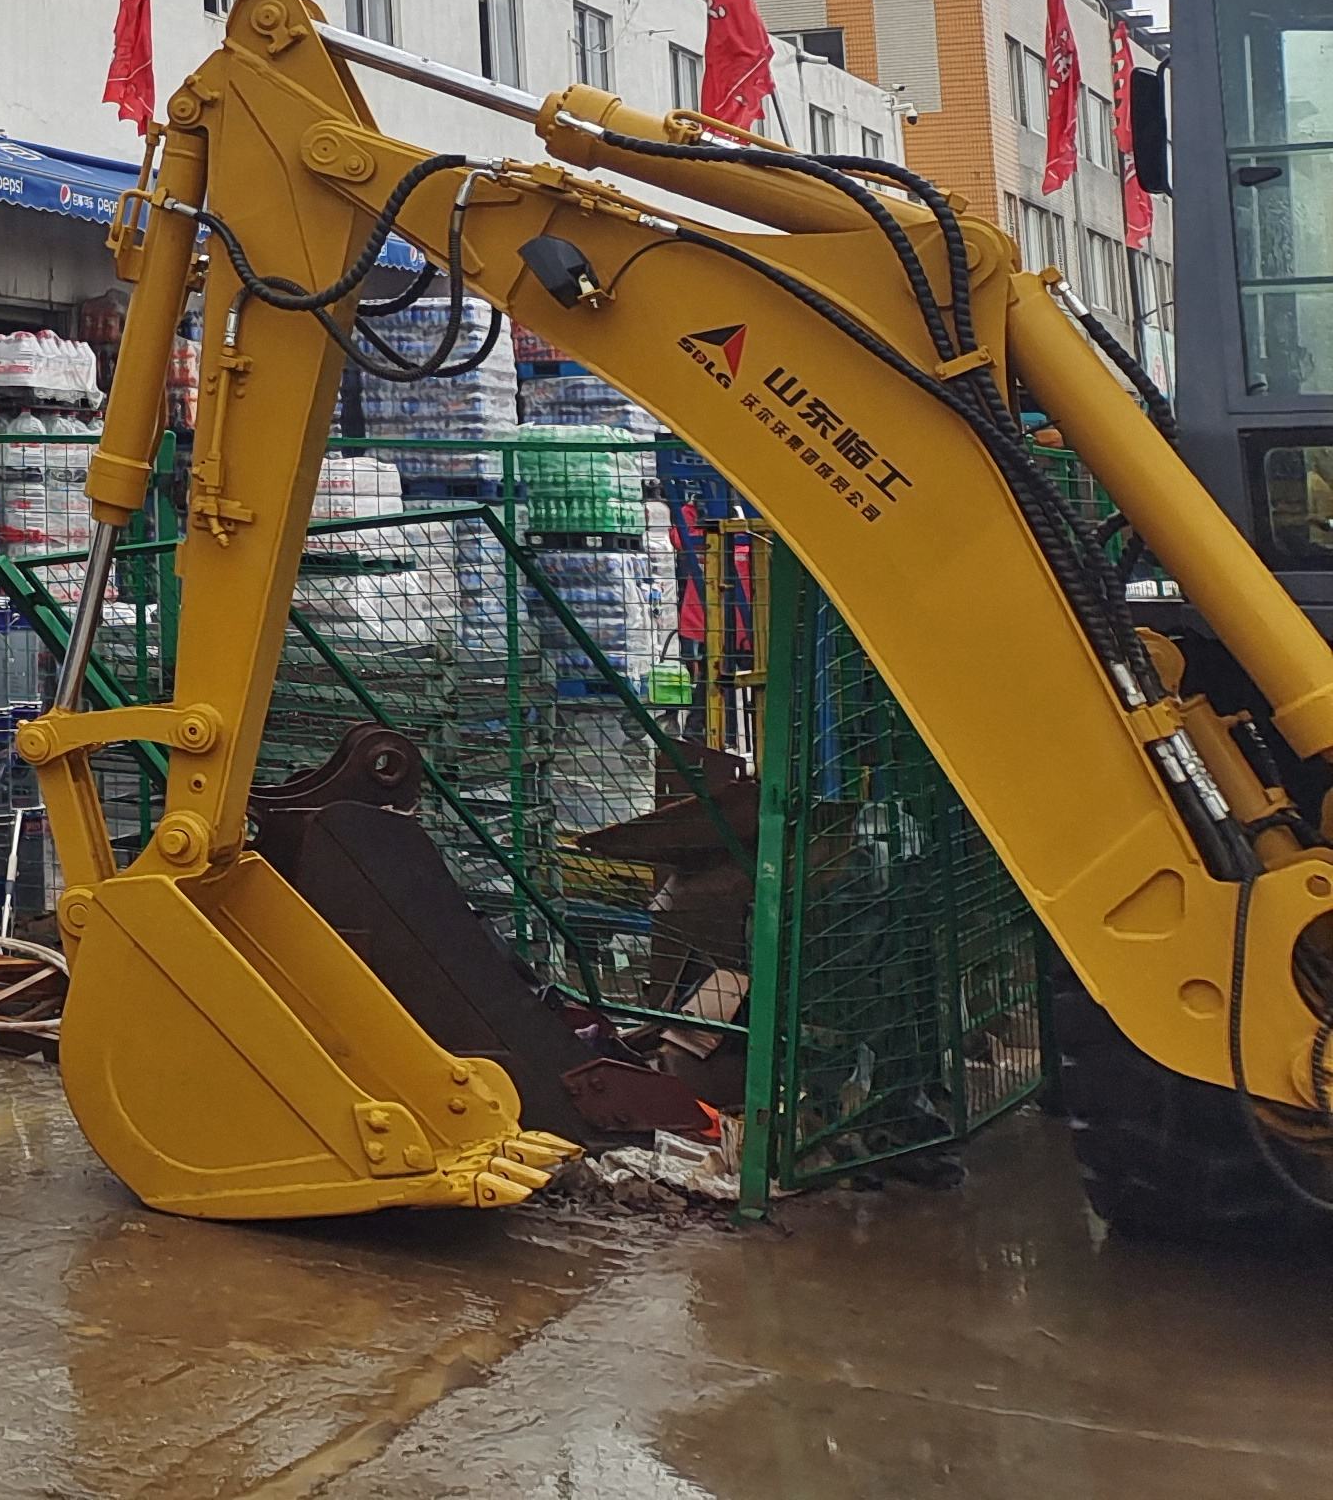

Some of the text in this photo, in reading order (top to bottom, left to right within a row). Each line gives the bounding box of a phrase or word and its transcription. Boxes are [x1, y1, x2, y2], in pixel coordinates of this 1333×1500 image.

[98, 197, 119, 218] peps
[676, 336, 732, 390] SDLG
[740, 392, 882, 523] 沃尔沃集团成员公司
[763, 366, 913, 502] 山东临工
